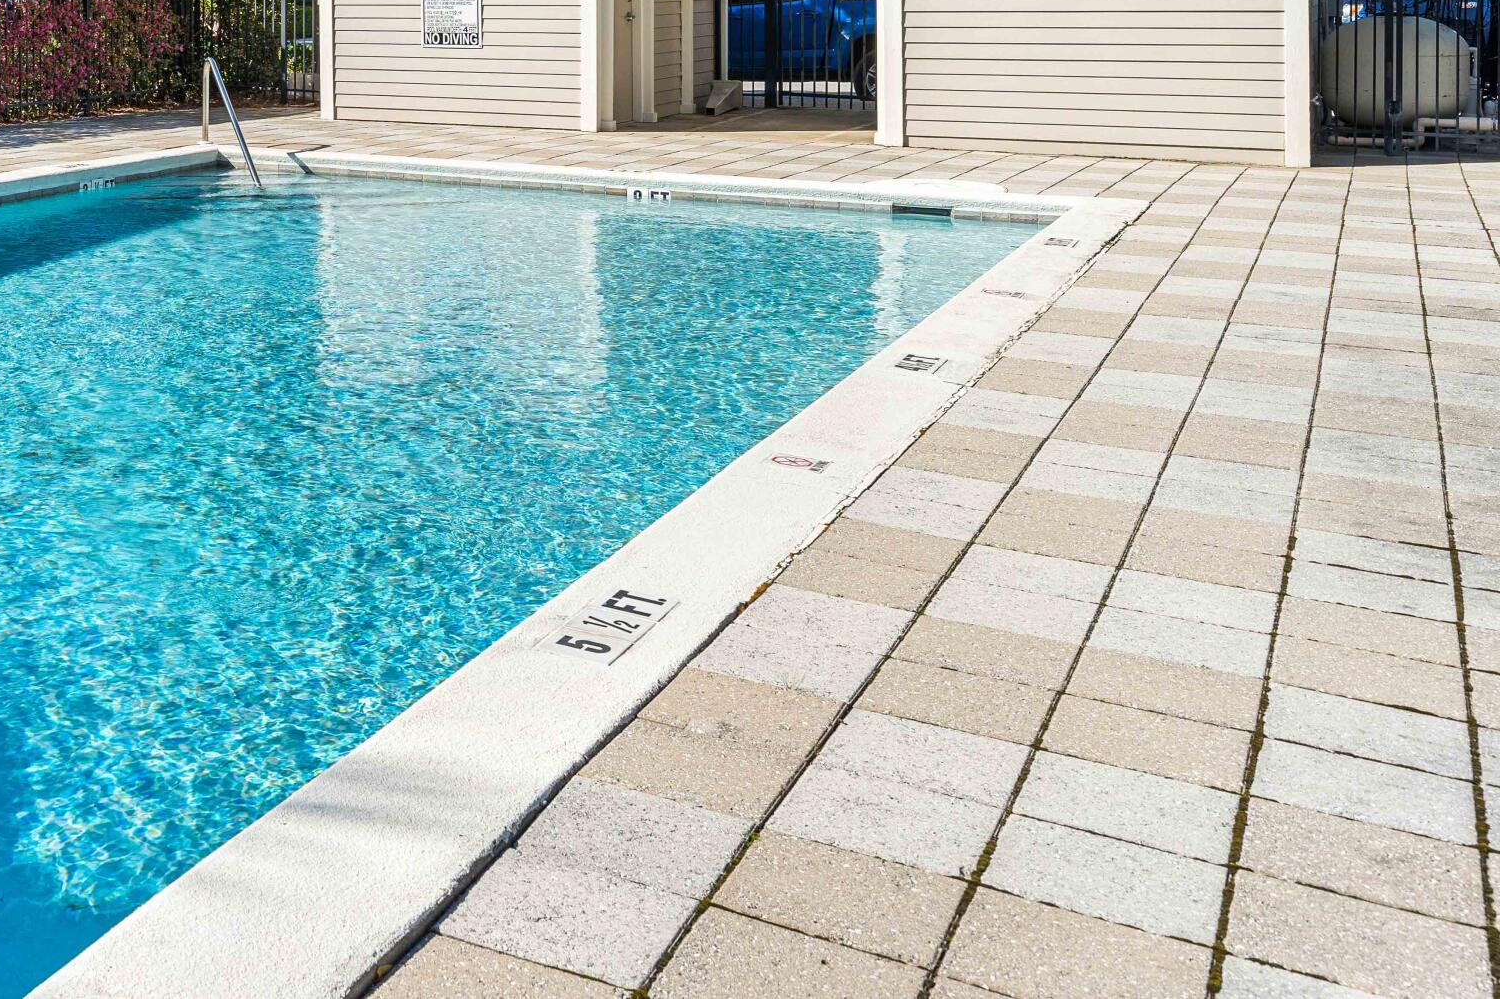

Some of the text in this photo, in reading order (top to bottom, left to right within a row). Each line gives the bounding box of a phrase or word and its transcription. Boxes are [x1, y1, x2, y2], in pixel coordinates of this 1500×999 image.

[425, 33, 478, 45] NO DIVING
[555, 634, 612, 654] 5
